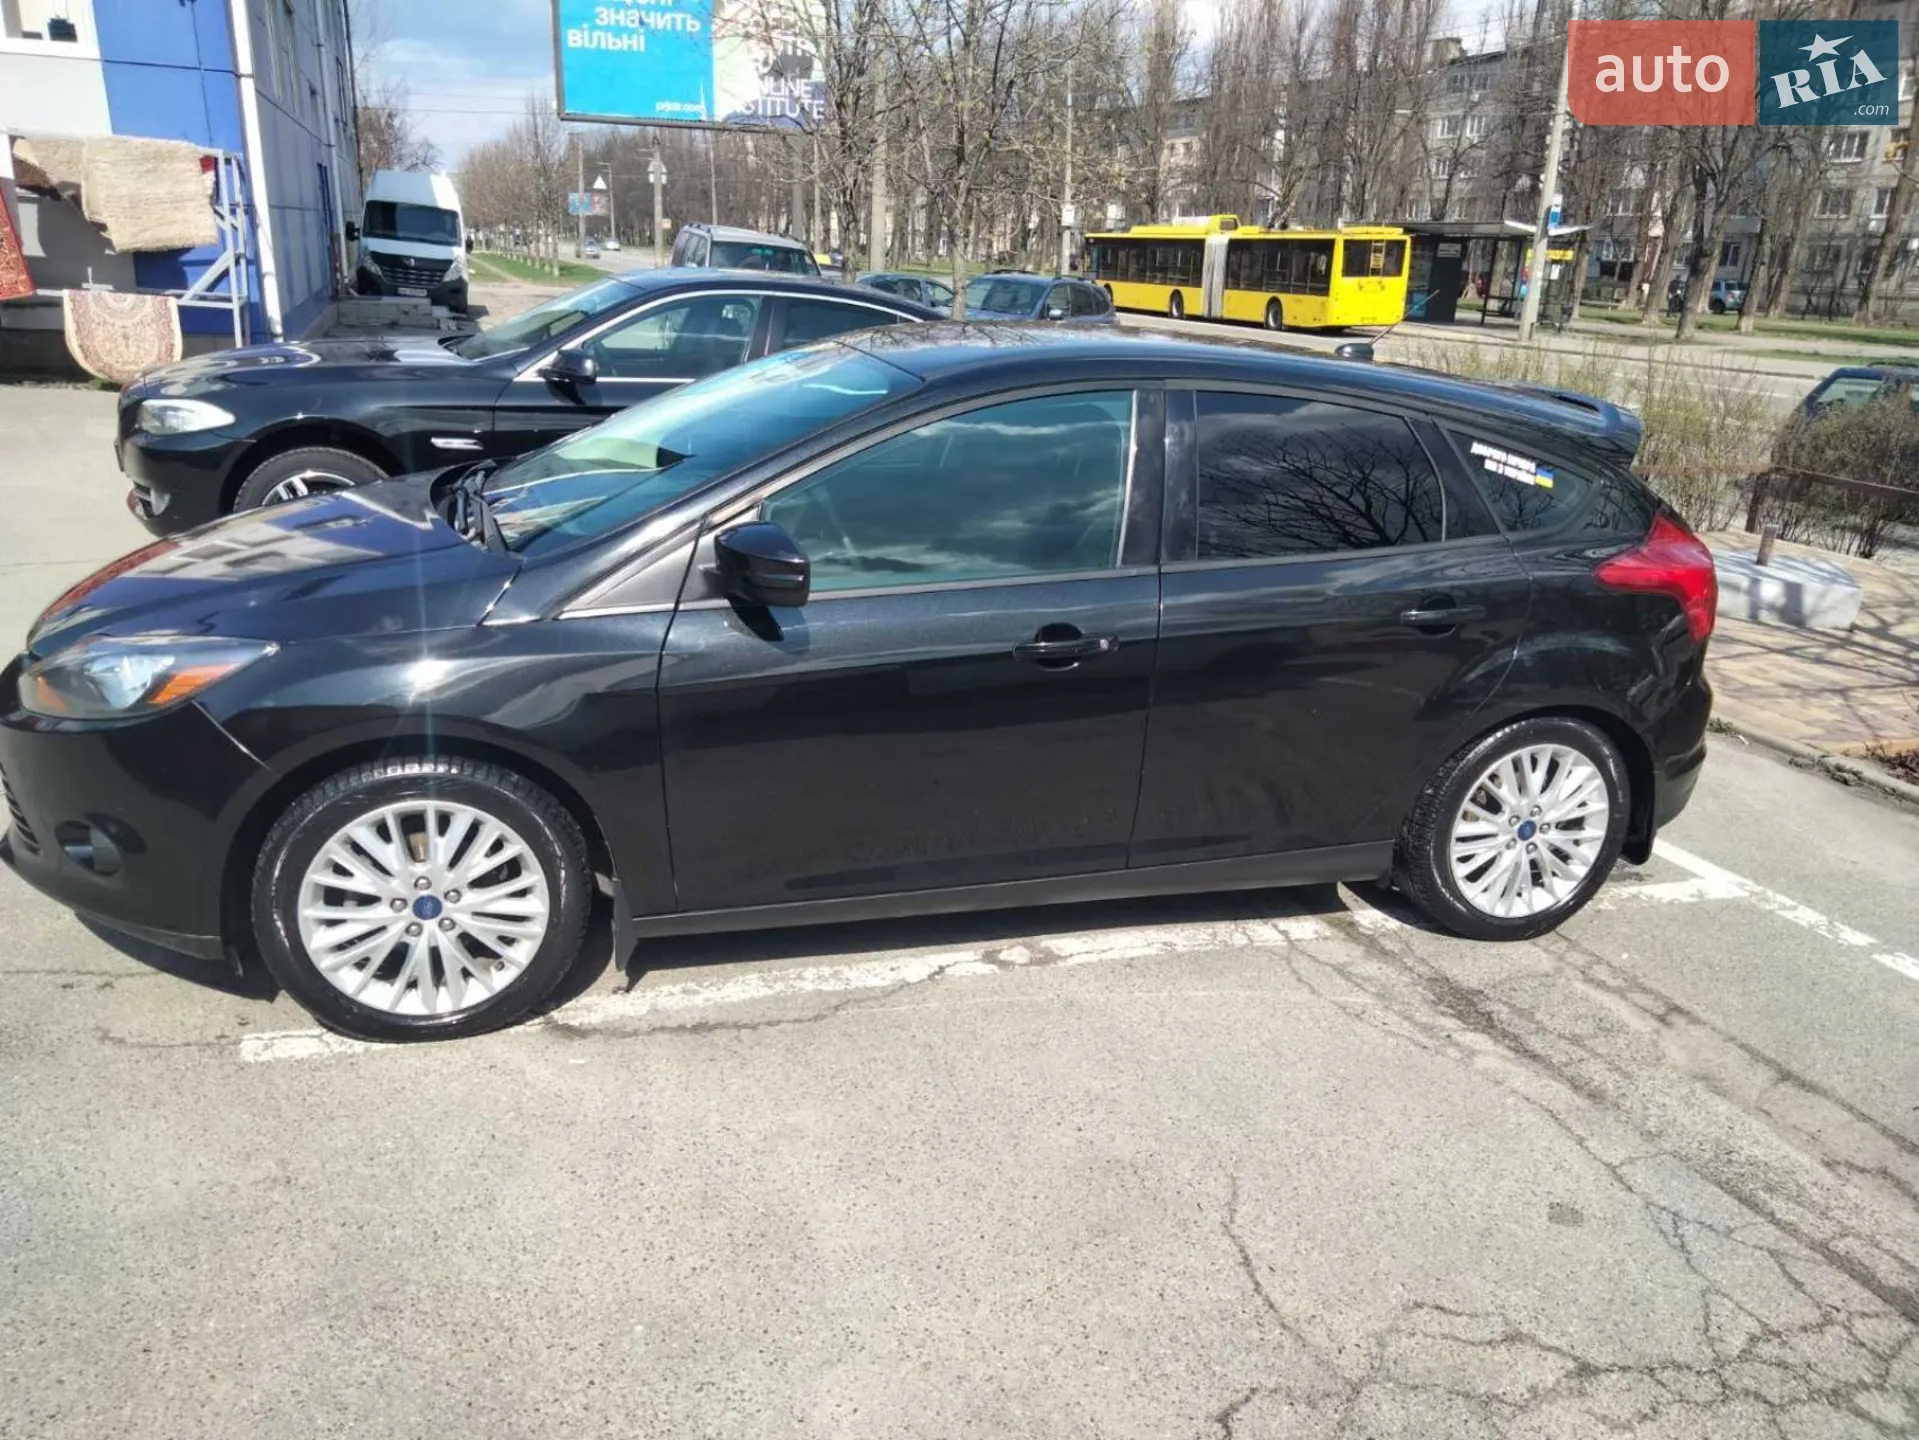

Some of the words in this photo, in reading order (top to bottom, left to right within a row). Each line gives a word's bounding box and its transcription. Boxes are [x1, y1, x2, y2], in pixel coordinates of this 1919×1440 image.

[595, 6, 701, 32] значить
[567, 23, 645, 52] вільні
[758, 74, 812, 99] NLINE
